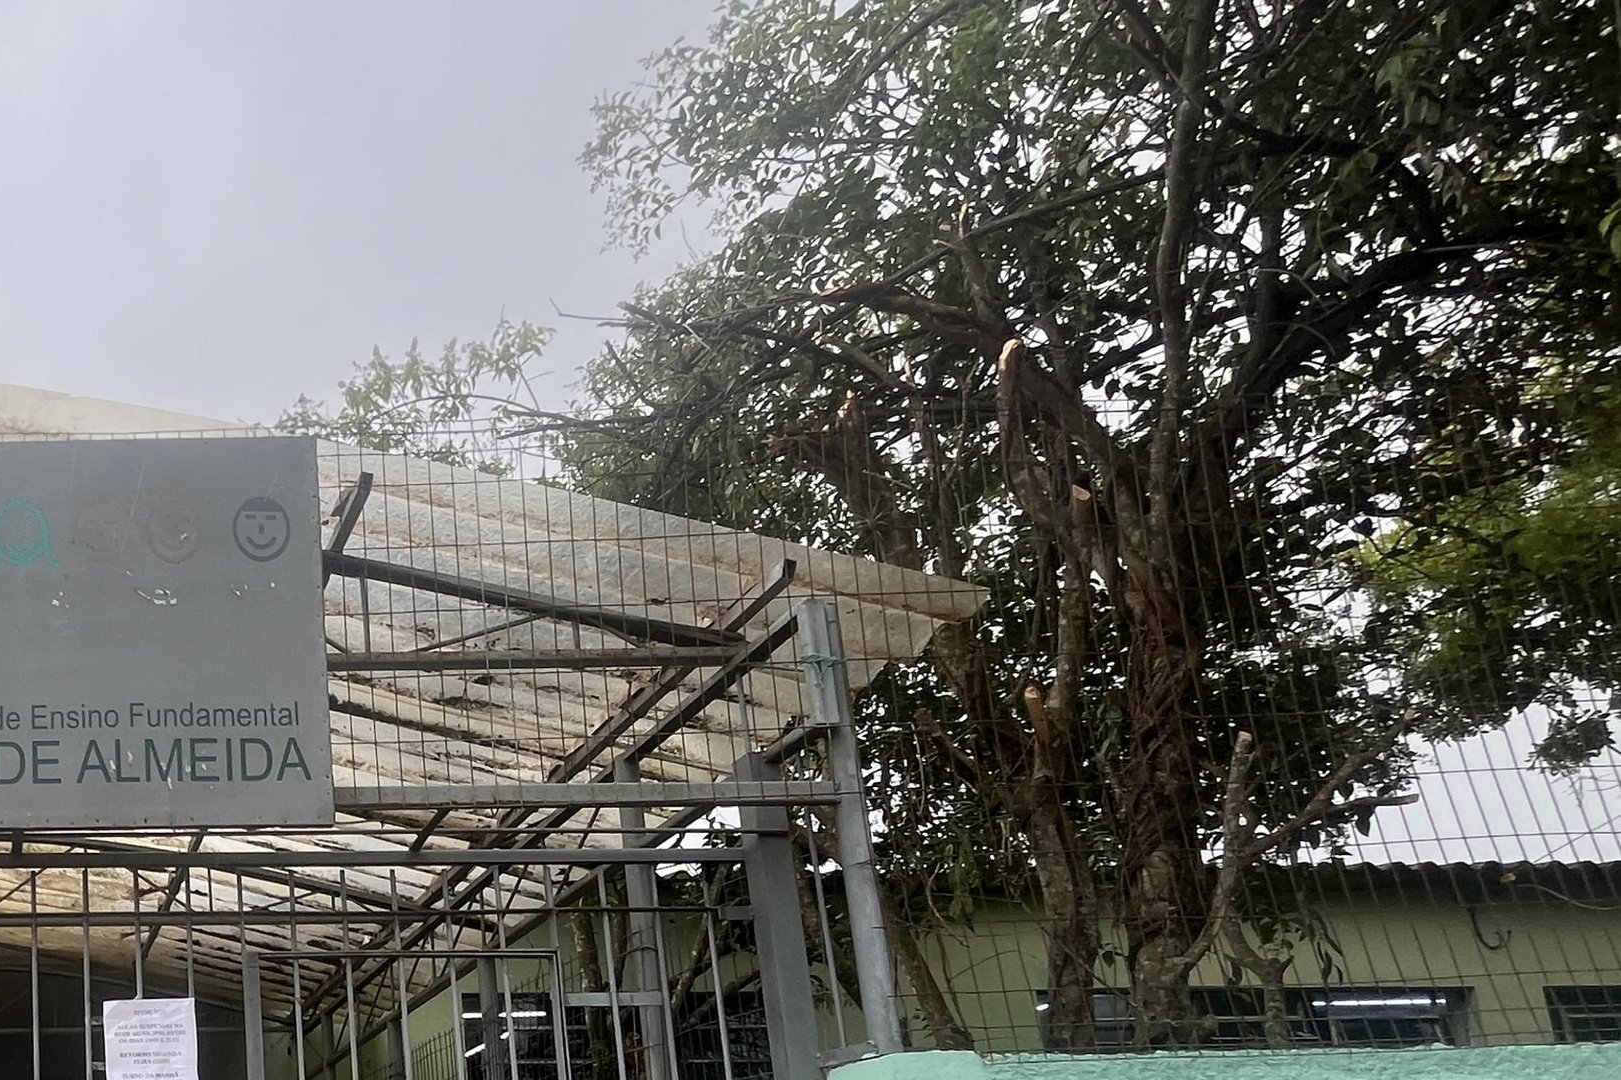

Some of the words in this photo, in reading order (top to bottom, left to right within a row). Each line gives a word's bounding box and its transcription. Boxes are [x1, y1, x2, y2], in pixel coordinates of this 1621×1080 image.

[31, 703, 119, 730] Ensino
[129, 701, 300, 728] Fundamental
[76, 737, 313, 784] ALMEIDA
